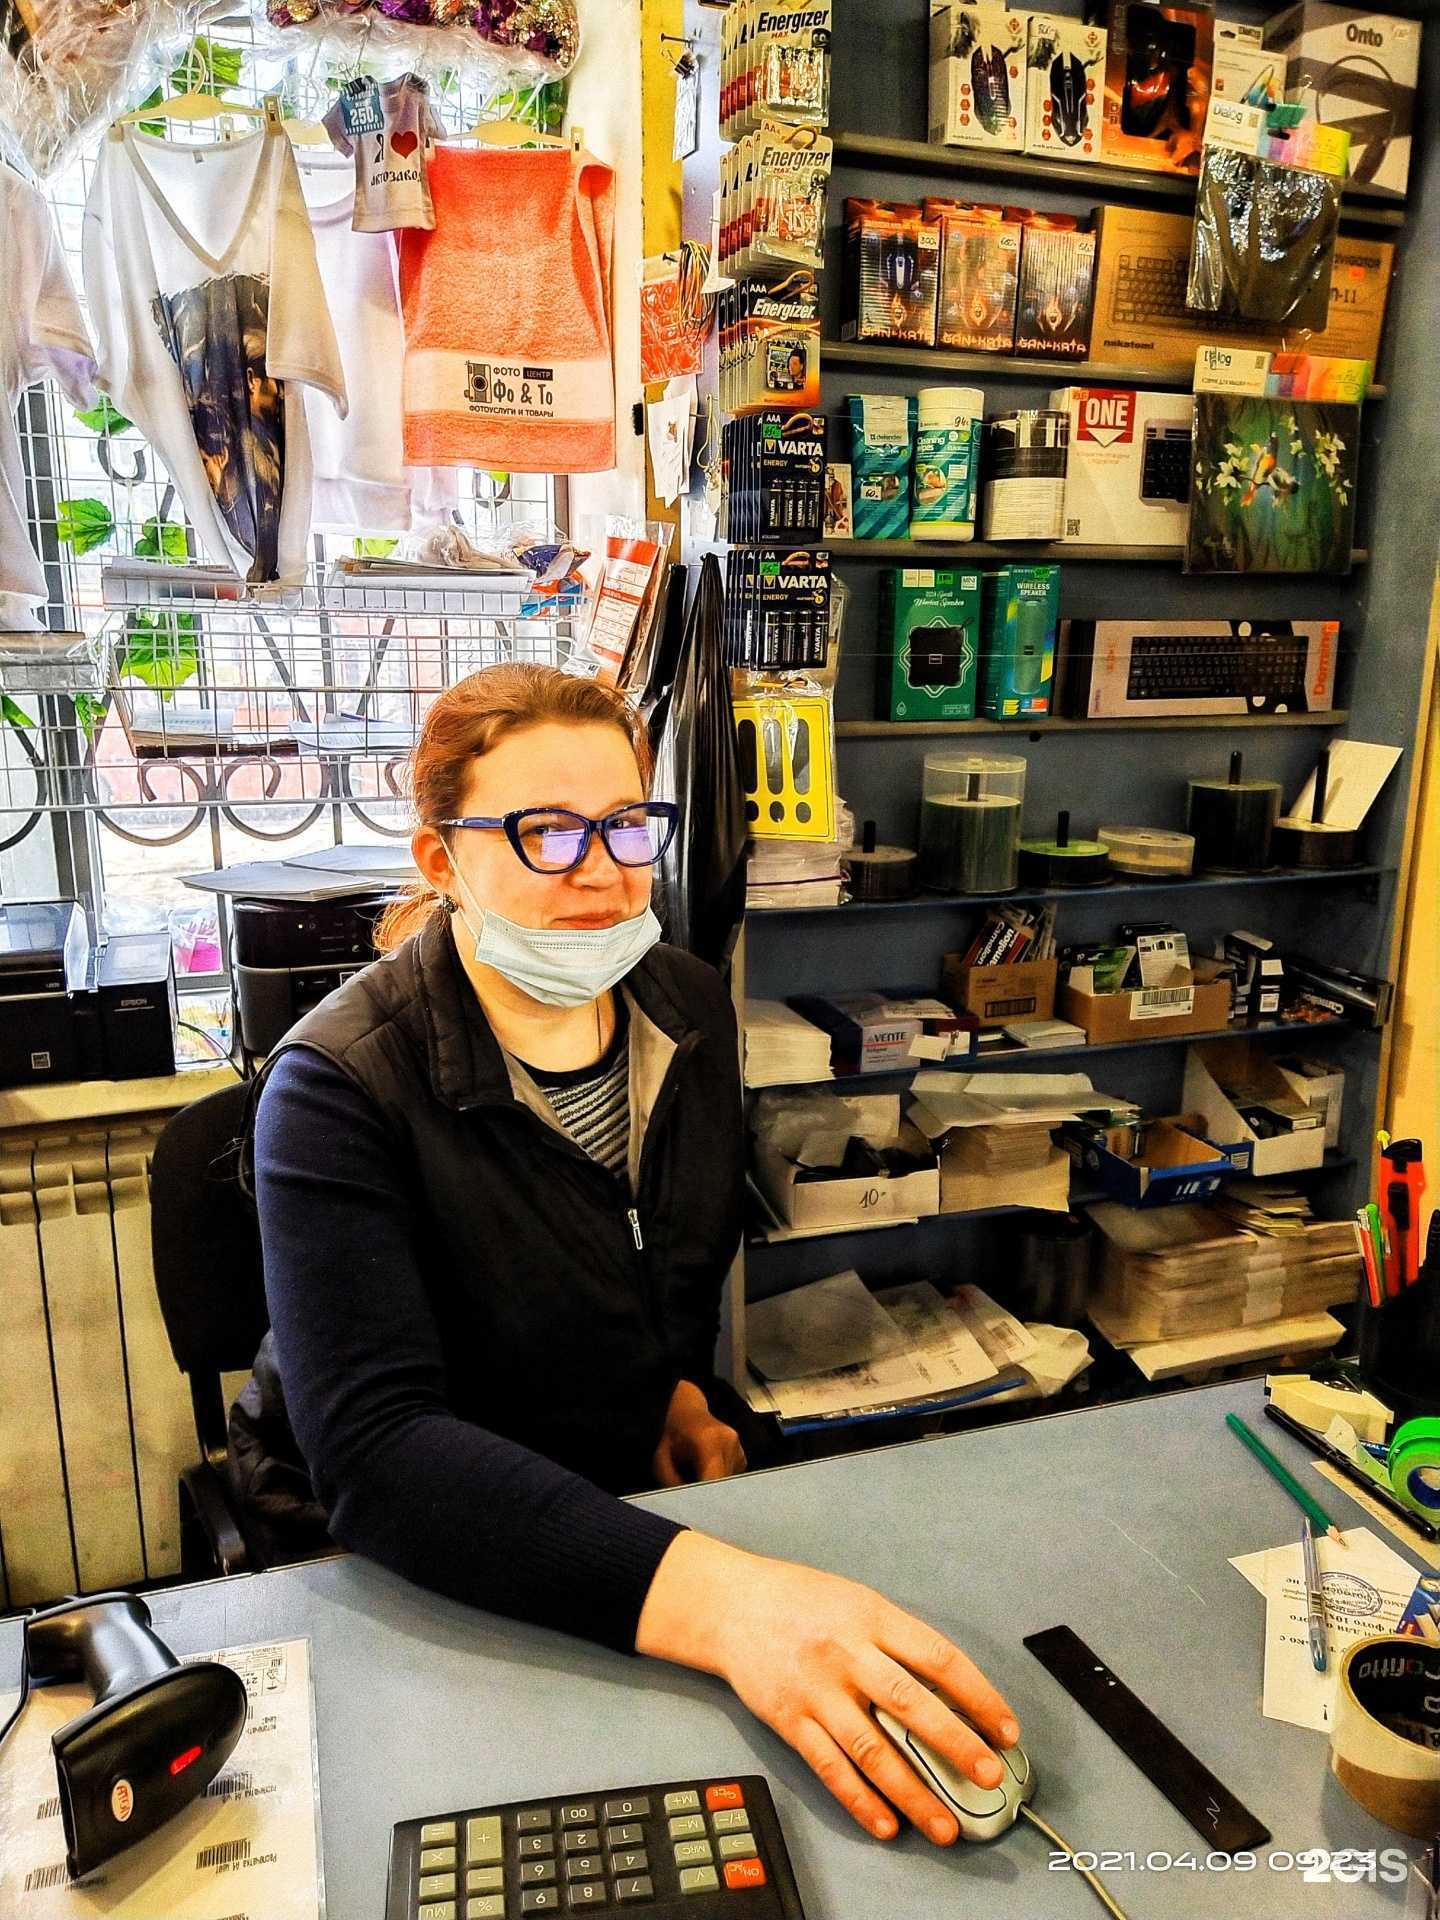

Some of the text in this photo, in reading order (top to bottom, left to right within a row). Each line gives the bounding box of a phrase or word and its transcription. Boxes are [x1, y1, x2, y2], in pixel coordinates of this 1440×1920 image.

[758, 10, 829, 33] Energizer
[1346, 24, 1383, 47] Onto
[1213, 103, 1243, 125] Dialog
[375, 133, 384, 163] Я
[761, 147, 830, 171] Energizer
[750, 284, 767, 294] AAA
[753, 299, 815, 320] Energizer
[1104, 339, 1154, 350] nakatomi
[493, 367, 551, 378] ФОТО ЦЕНТР
[493, 379, 553, 405] Фо & То
[469, 405, 517, 416] ФОТОУСЛУГИ
[525, 409, 554, 418] ТОВАРЫ
[1086, 398, 1129, 427] ONE
[766, 415, 781, 423] AAA
[778, 441, 824, 457] VARTA
[765, 552, 776, 560] AA
[777, 576, 829, 589] VARTA
[763, 593, 789, 601] ENERGY
[1020, 589, 1047, 597] SPEAKER
[990, 929, 1014, 966] amelion
[570, 1808, 588, 1818] 00
[623, 1803, 633, 1812] 0
[577, 1833, 587, 1845] 2
[622, 1829, 629, 1839] 1
[532, 1839, 542, 1849] 3
[580, 1859, 590, 1869] 5
[626, 1855, 636, 1866] 4
[534, 1864, 545, 1877] 6
[583, 1886, 593, 1898] 8
[631, 1880, 640, 1892] 7
[535, 1891, 546, 1904] 9
